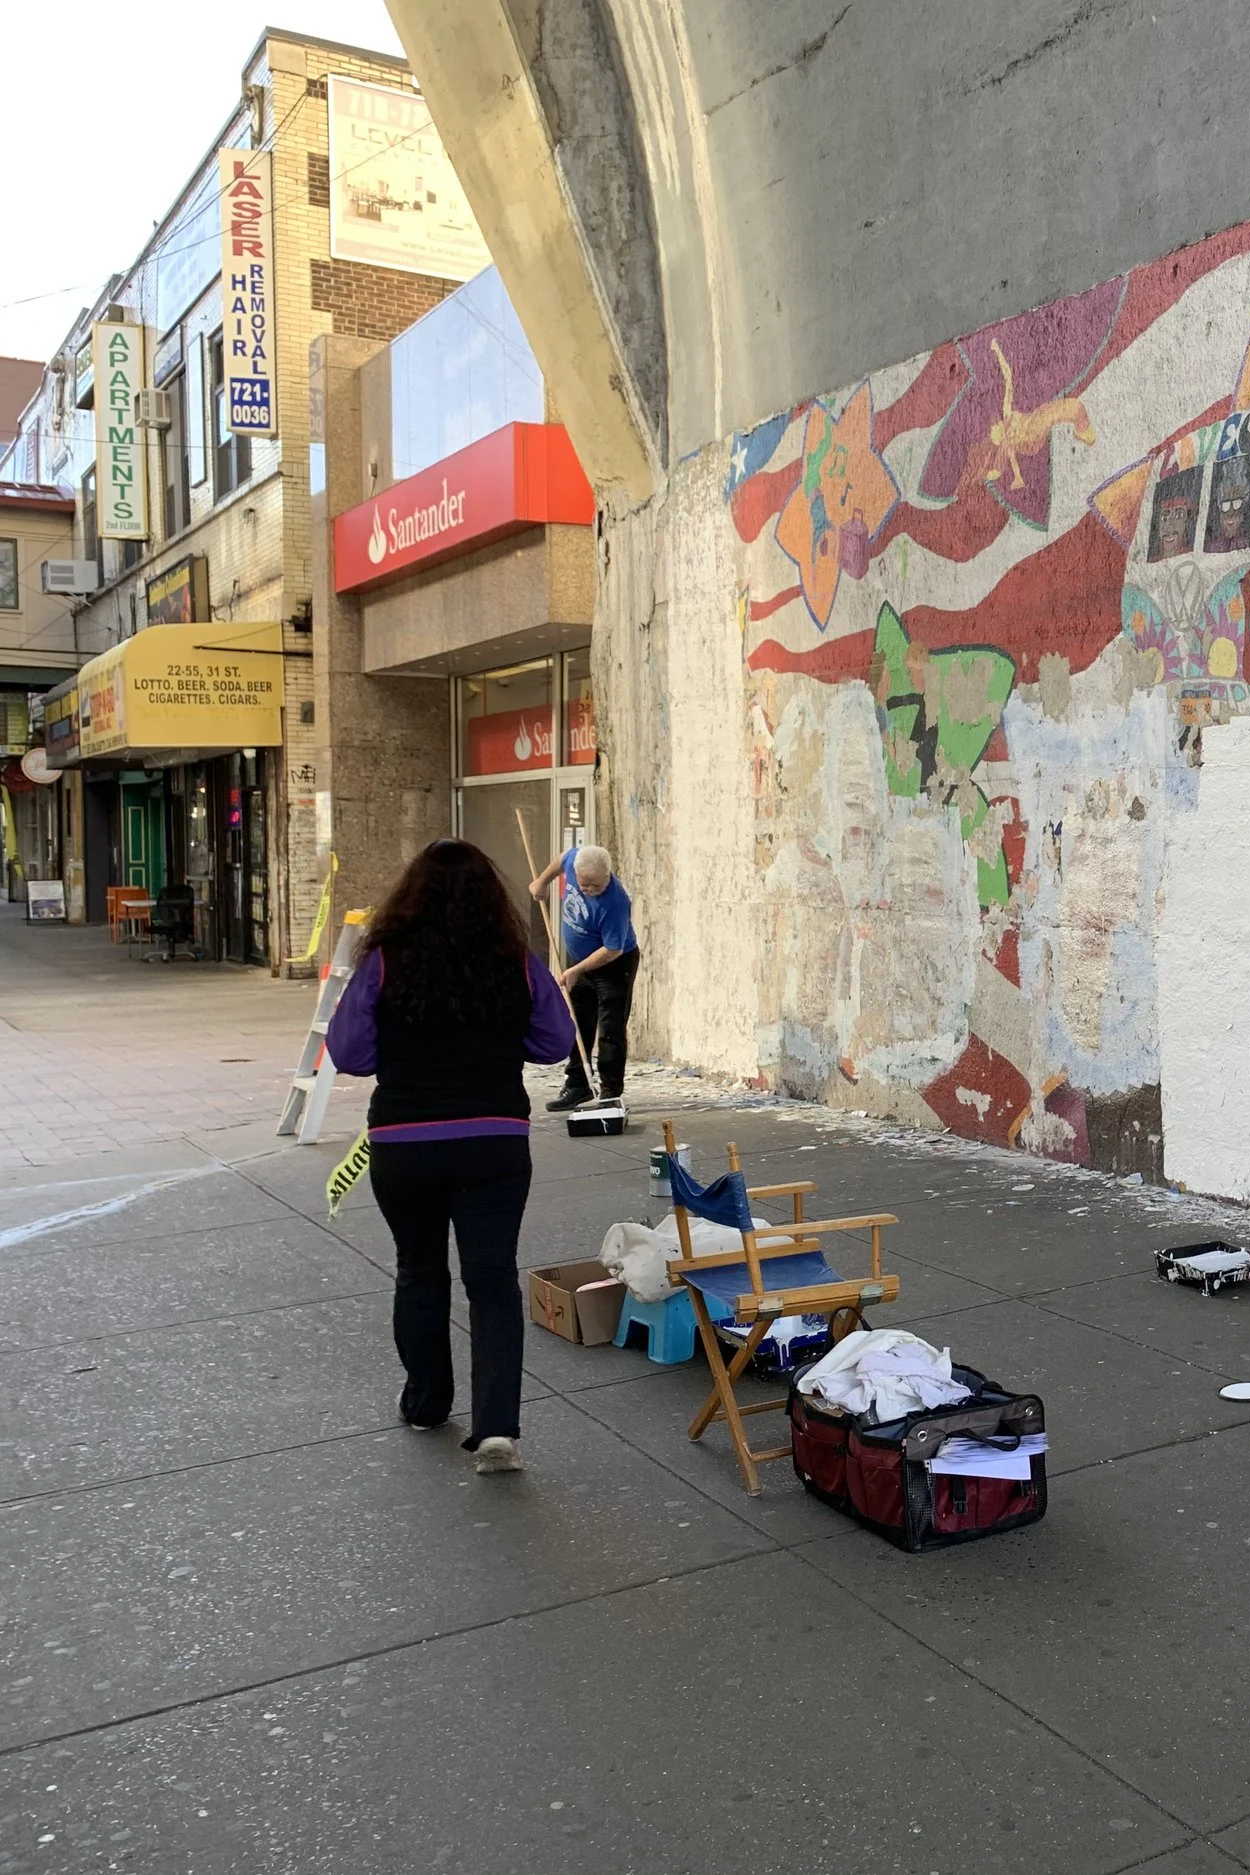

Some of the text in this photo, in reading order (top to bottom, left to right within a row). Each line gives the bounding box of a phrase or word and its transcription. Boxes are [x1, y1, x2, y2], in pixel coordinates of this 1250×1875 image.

[351, 123, 433, 156] LEVEL
[228, 160, 265, 258] LASER
[231, 273, 247, 357] HAIR
[250, 263, 267, 375] REMOVAL
[231, 381, 269, 402] 721-
[108, 332, 134, 519] APARTMENTS
[232, 404, 269, 425] 0036
[388, 478, 465, 555] Santander
[134, 678, 273, 693] LOTTO. BEER. SODA. BEER
[167, 664, 242, 679] 22-55, 31 ST.
[218, 693, 261, 706] CIGARS.
